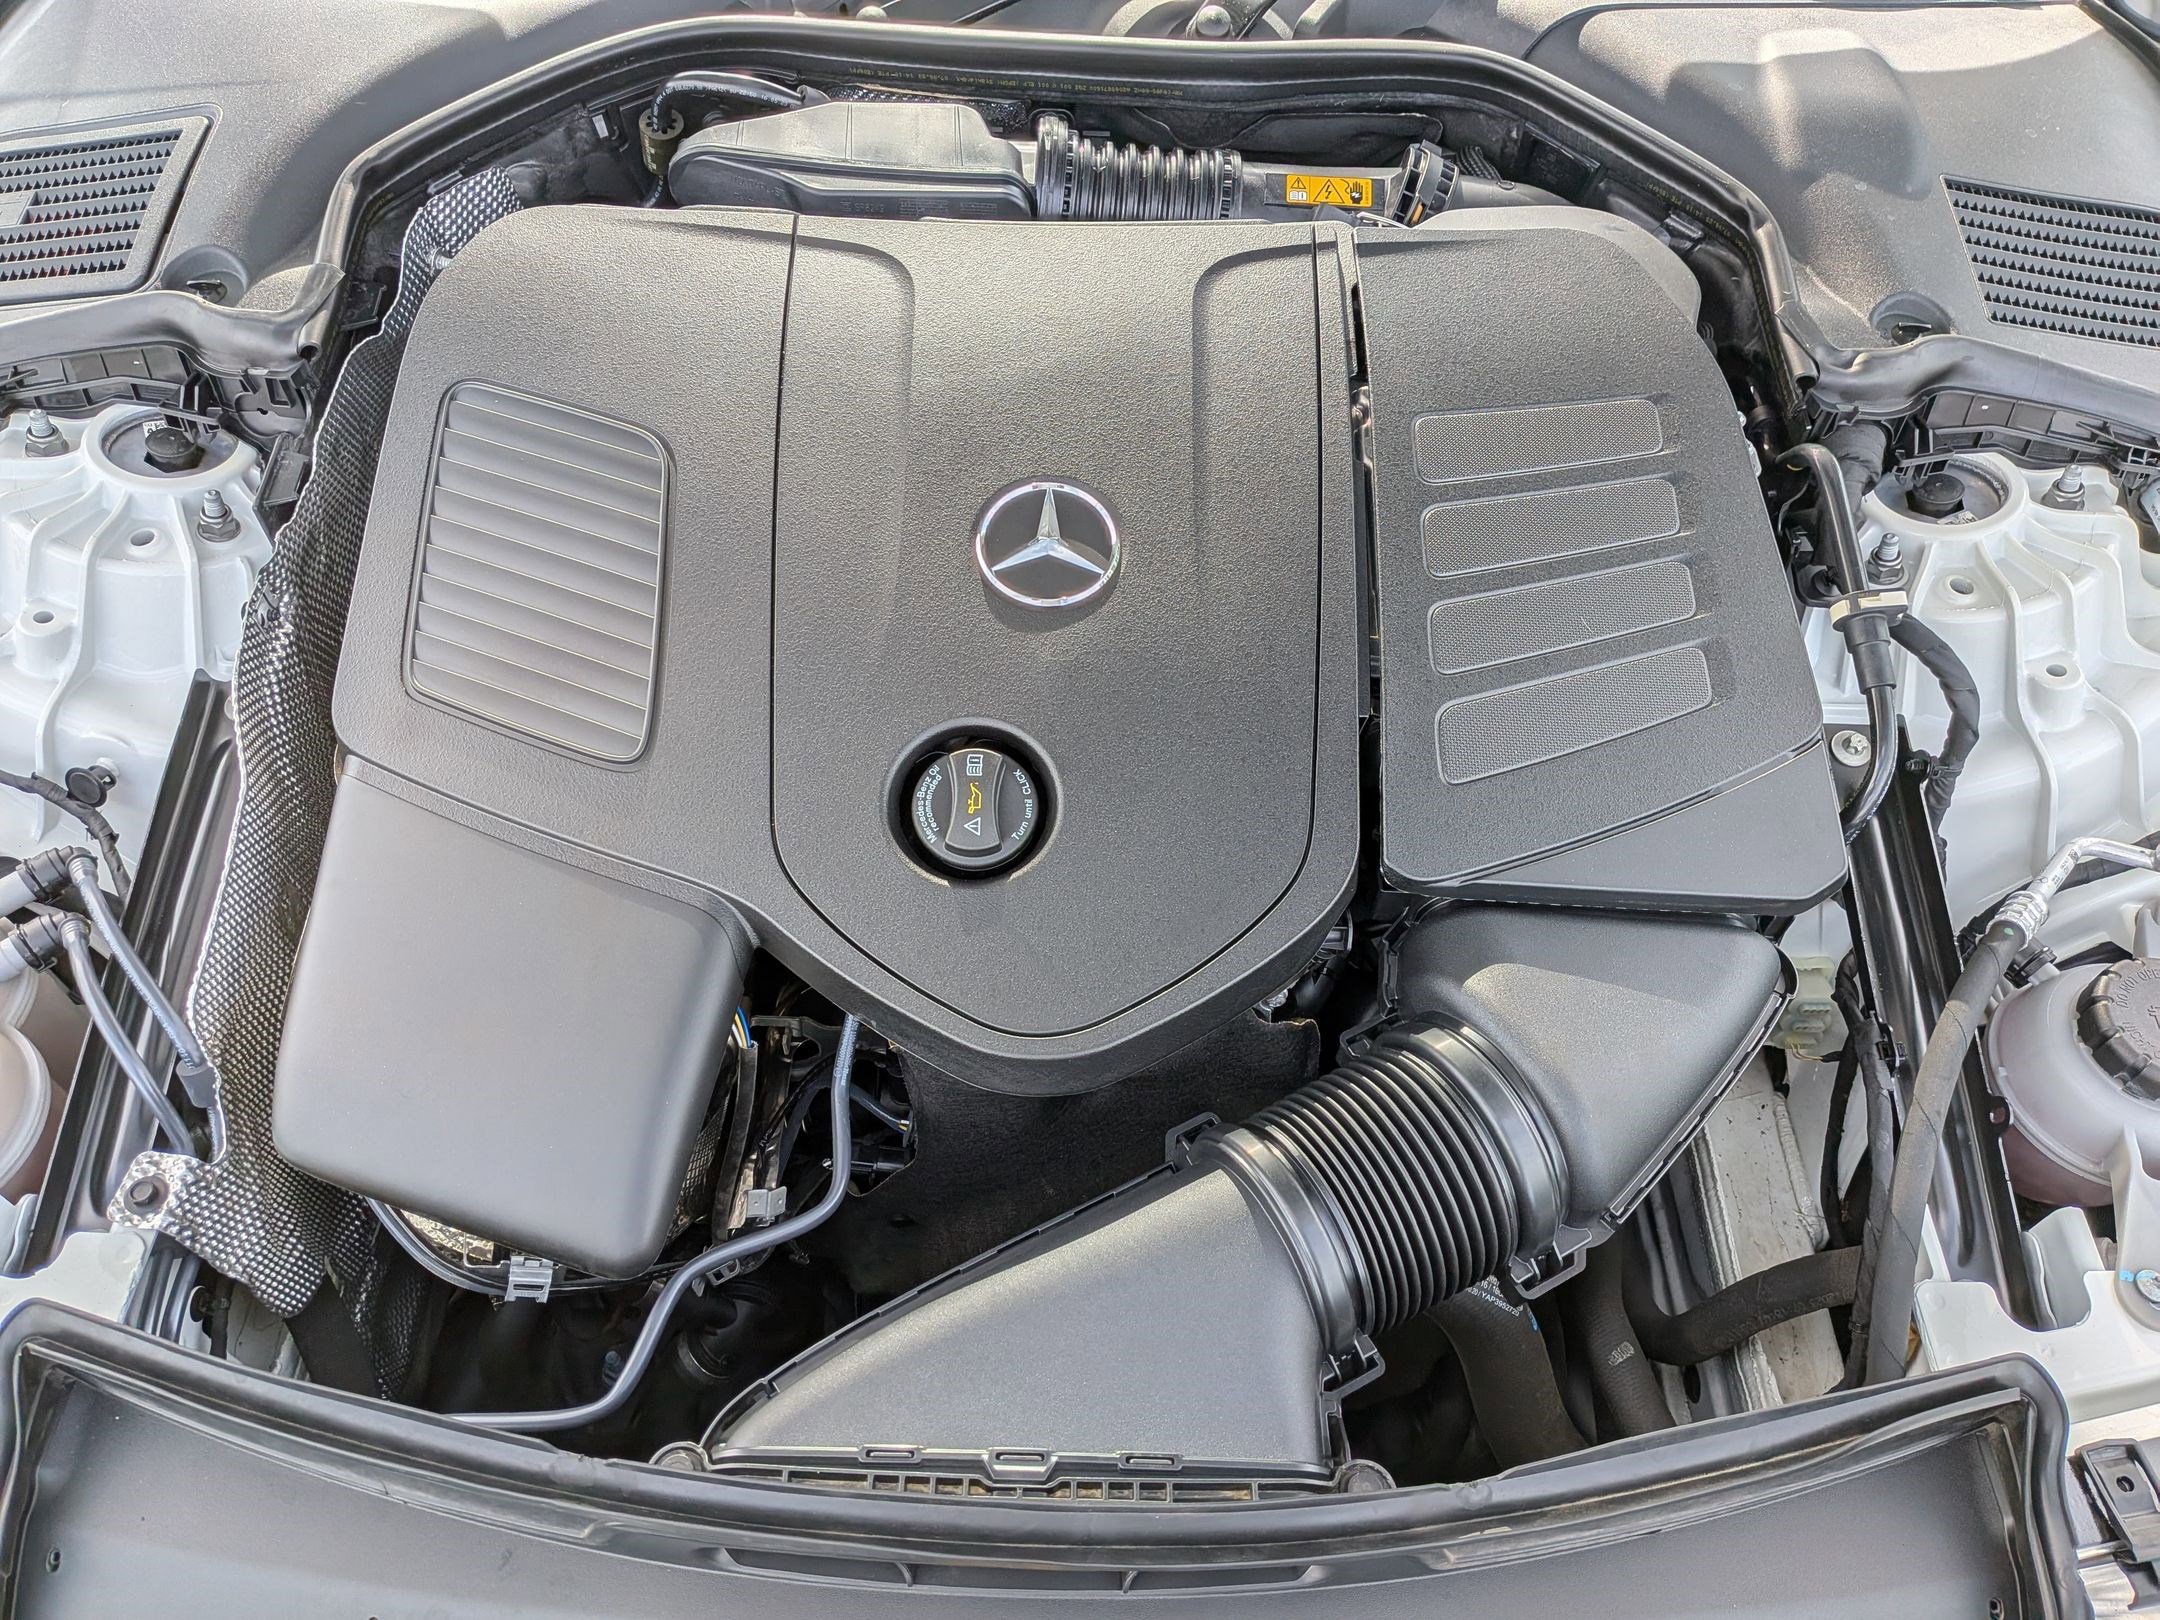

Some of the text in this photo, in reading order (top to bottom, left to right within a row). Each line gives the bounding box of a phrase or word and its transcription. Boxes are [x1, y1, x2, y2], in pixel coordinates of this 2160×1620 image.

[916, 764, 940, 843] Mercedes-Benz Oil
[926, 774, 942, 831] recommended
[1011, 769, 1033, 840] Turn until CLICK
[2116, 993, 2129, 1008] DO
